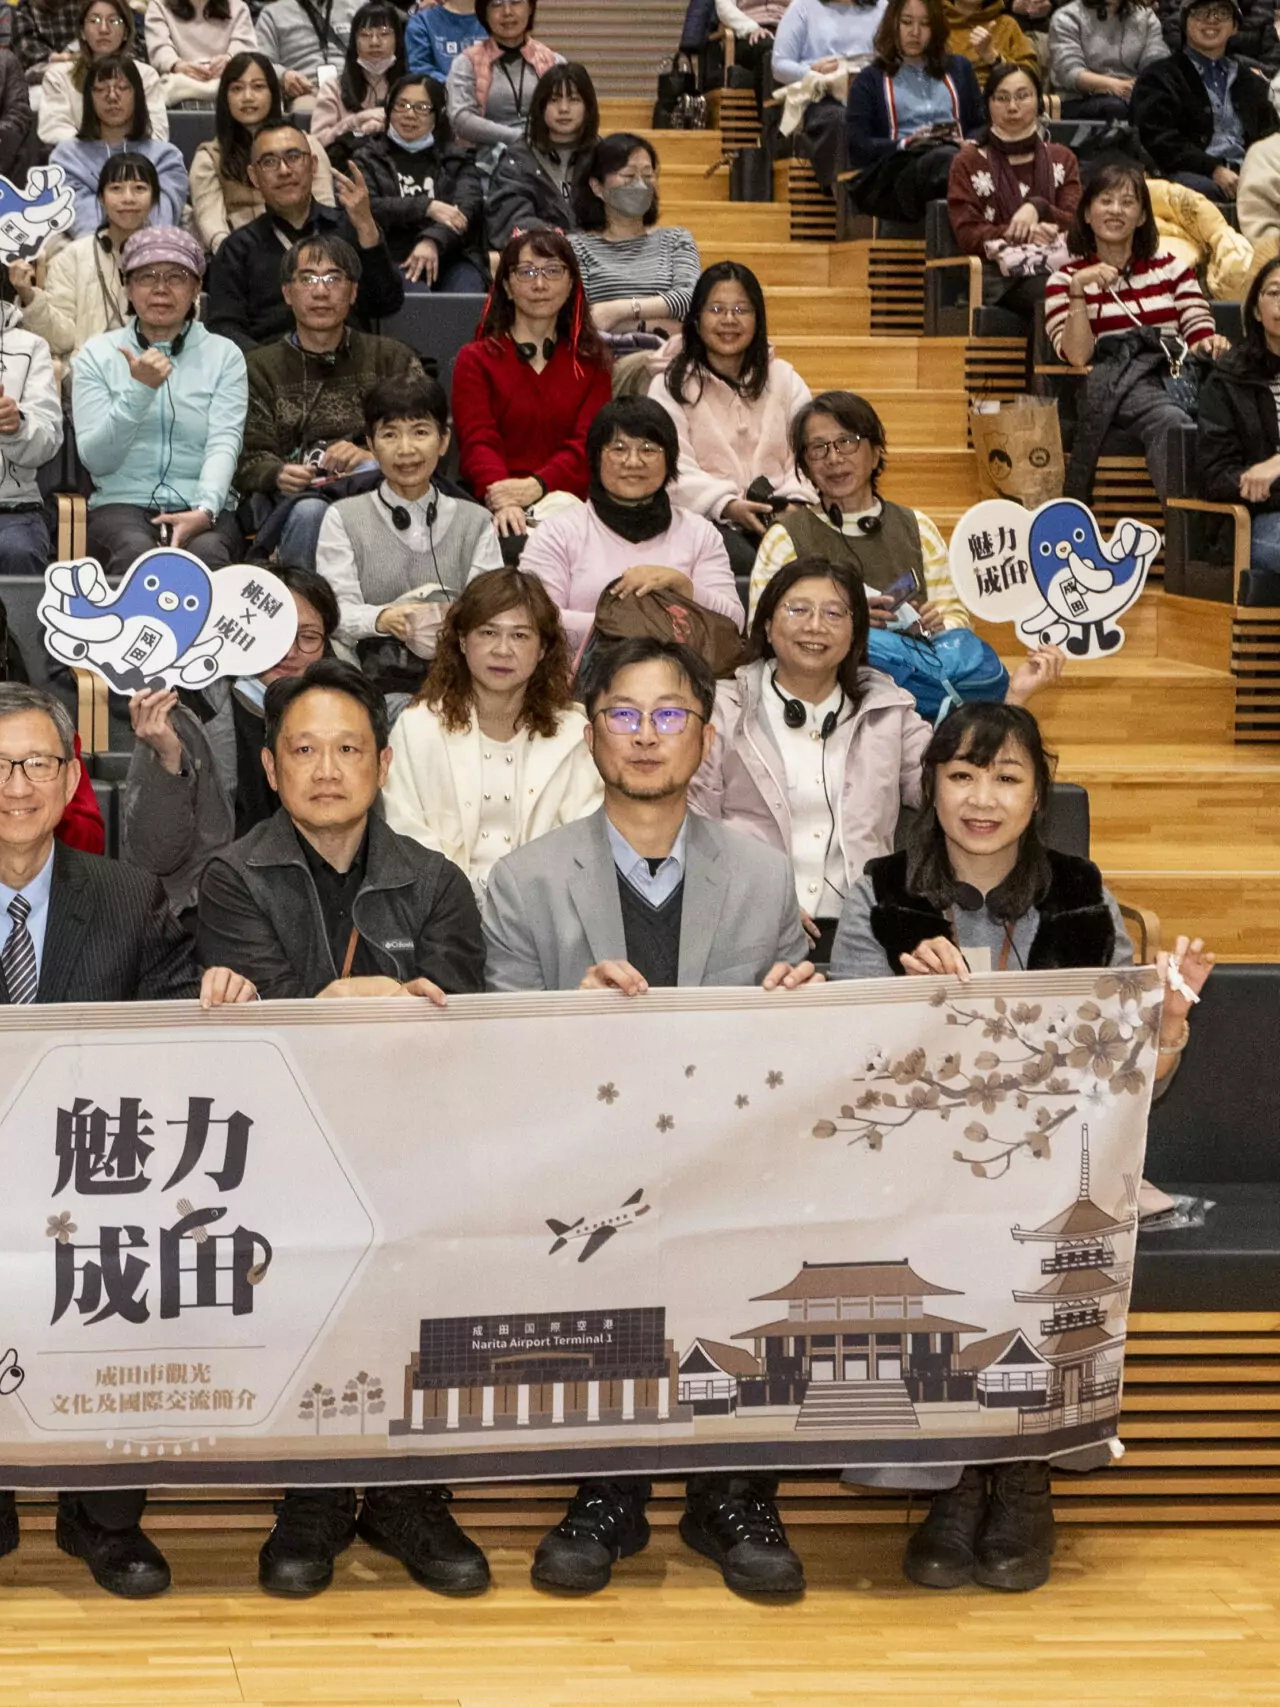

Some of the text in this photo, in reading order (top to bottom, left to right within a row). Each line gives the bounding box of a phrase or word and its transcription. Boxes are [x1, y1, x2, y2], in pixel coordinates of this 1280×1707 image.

[968, 526, 1016, 562] 魅力
[975, 556, 1029, 598] 成田
[240, 580, 283, 619] 桃園
[130, 632, 156, 661] 成田
[213, 615, 256, 652] 成田
[51, 1096, 254, 1197] 魅力
[47, 1212, 273, 1326] 成田
[472, 1333, 613, 1350] Narita Airport Terminal 1
[95, 1362, 211, 1387] 成田市觀光
[51, 1388, 257, 1415] 文化及國際交流簡介
